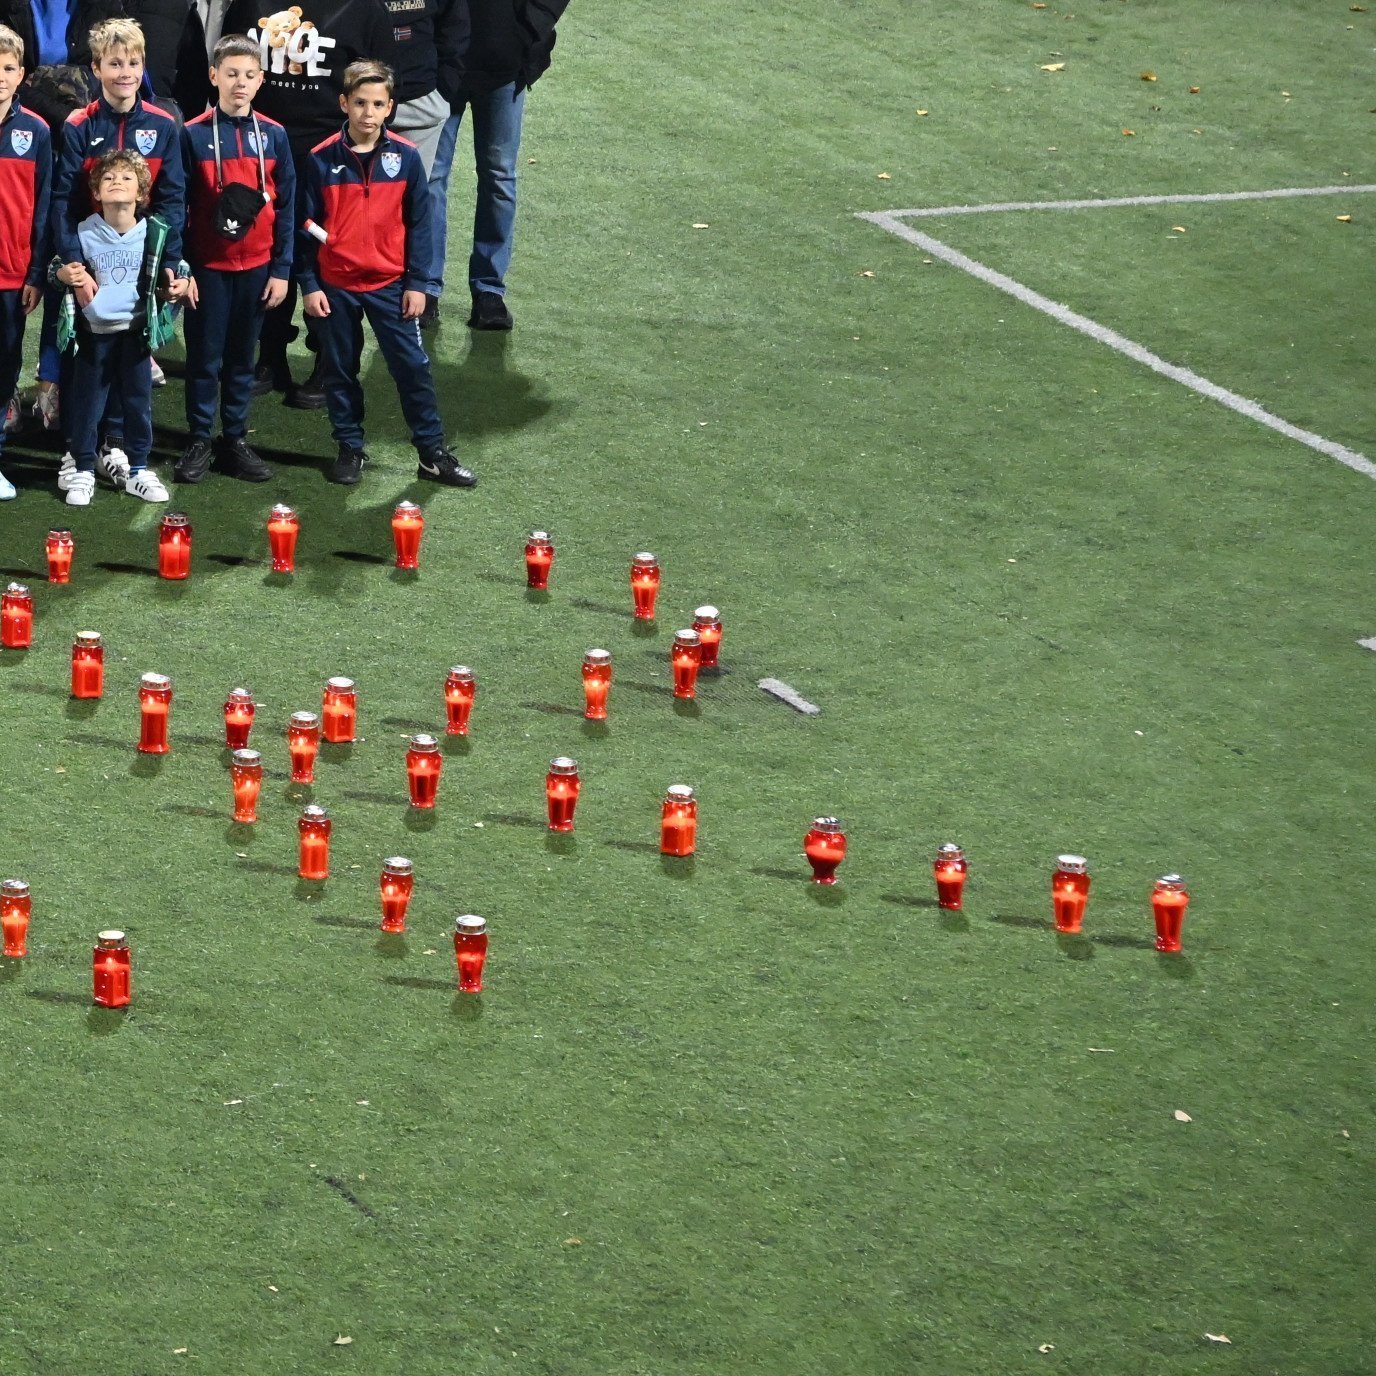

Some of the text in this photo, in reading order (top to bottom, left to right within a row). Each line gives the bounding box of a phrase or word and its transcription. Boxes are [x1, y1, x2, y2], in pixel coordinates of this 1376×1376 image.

[247, 25, 337, 76] NICE
[270, 79, 297, 89] meet
[301, 83, 320, 91] you
